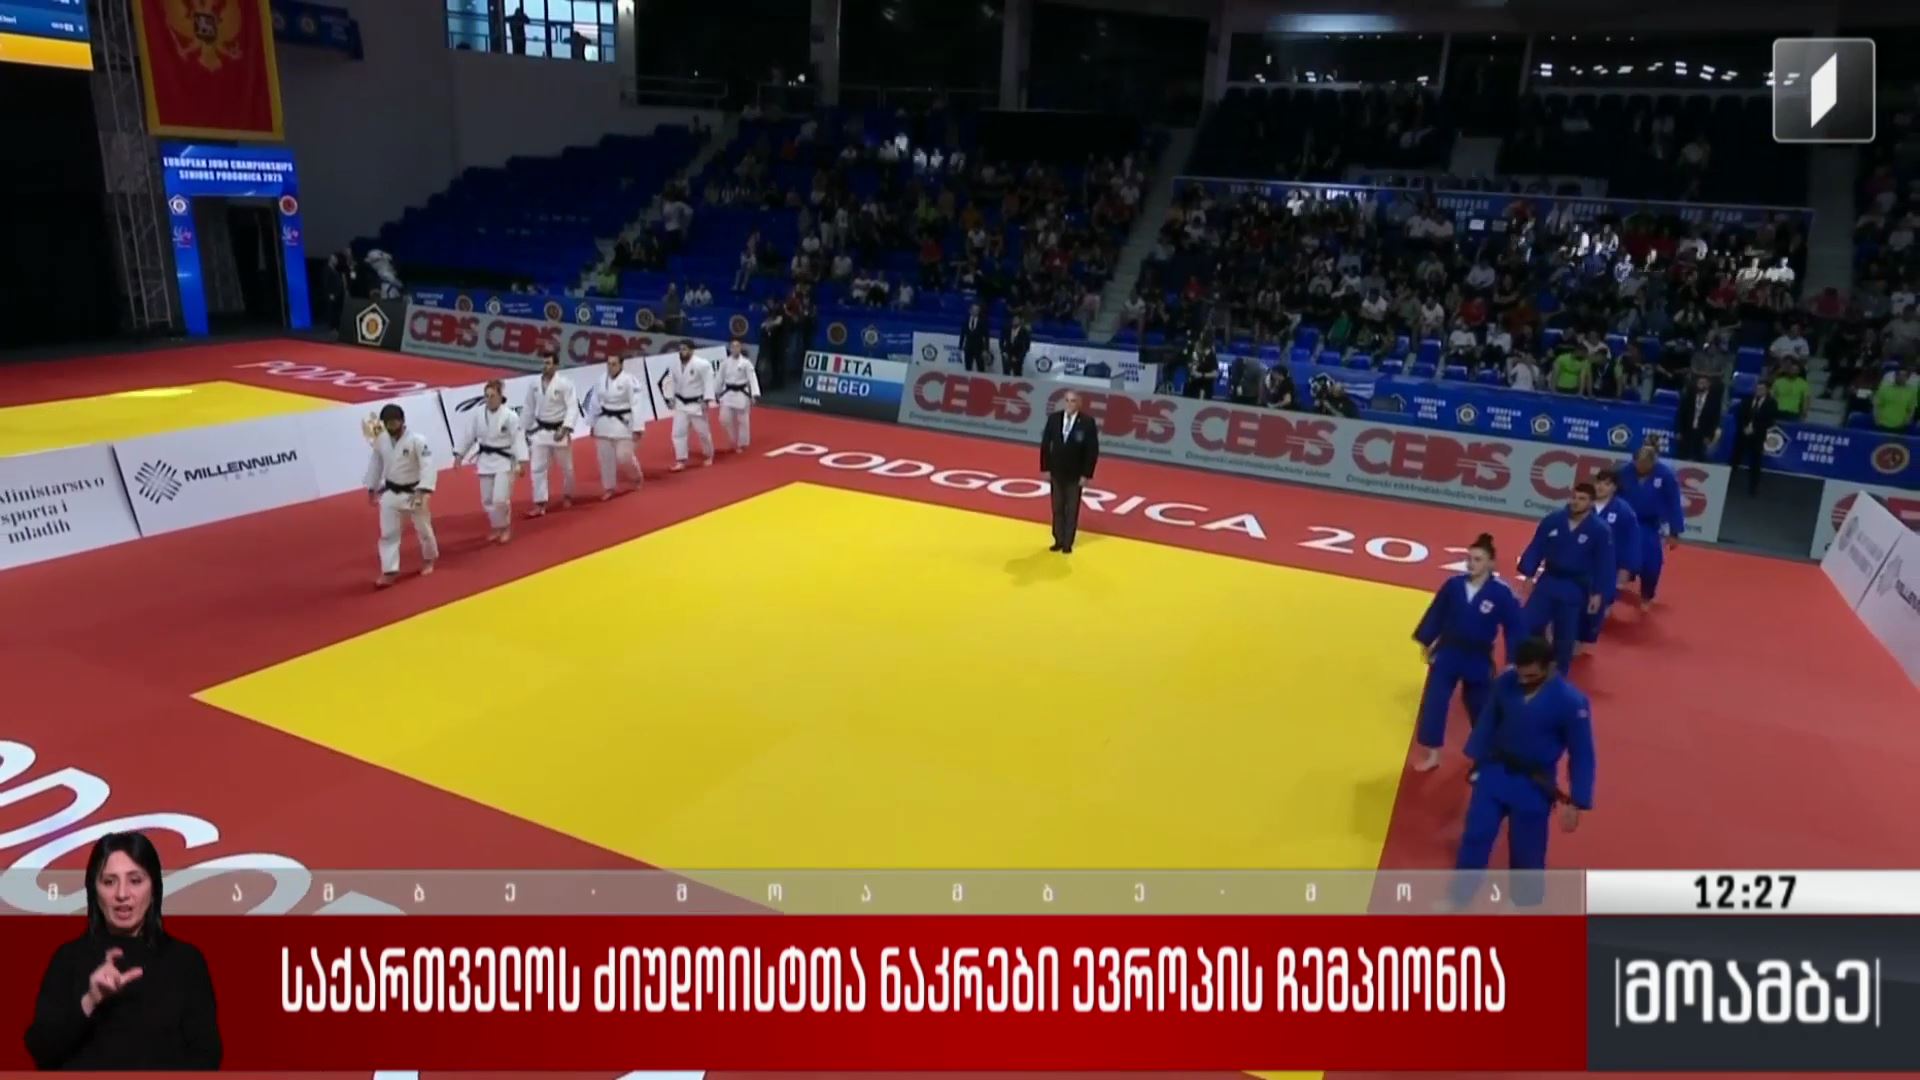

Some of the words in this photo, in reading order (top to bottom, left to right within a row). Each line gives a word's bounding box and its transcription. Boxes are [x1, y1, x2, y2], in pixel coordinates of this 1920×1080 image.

[843, 360, 873, 377] ITA
[838, 381, 870, 397] GEO
[913, 371, 1035, 424] CEDIS
[1190, 406, 1338, 467] CEDIS
[1796, 431, 1850, 446] EUROPEAN
[184, 450, 298, 482] MILLENNIUM
[1351, 427, 1514, 491] CEDIS
[1801, 452, 1835, 465] UNION
[763, 442, 1267, 541] PODGORICA
[8, 519, 71, 544] mladih
